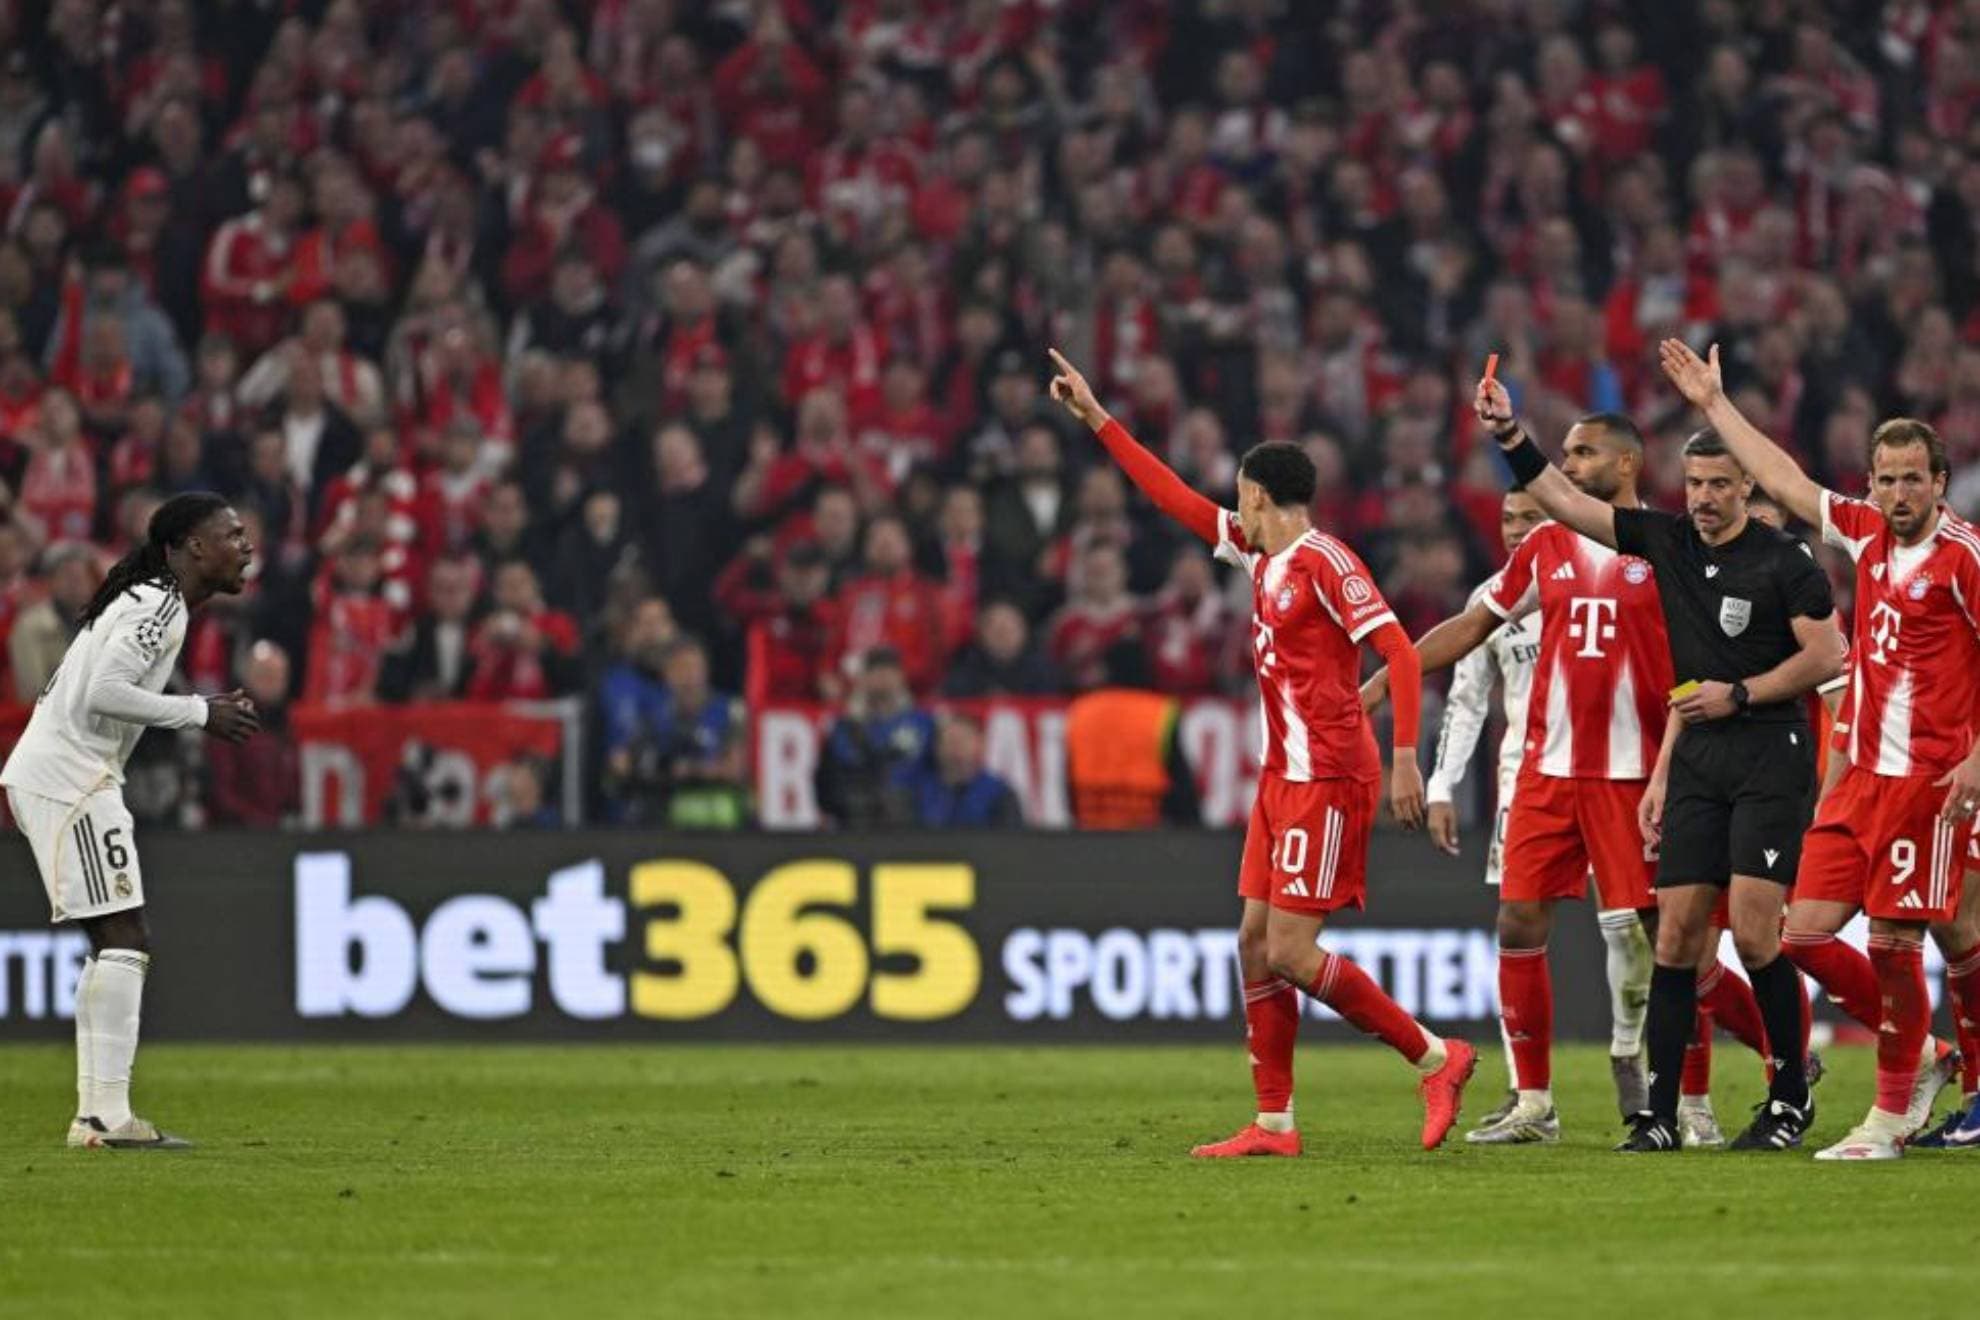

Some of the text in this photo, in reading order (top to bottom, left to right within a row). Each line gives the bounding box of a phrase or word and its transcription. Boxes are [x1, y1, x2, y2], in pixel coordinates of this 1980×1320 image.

[1569, 597, 1616, 657] T
[1869, 600, 1901, 665] T
[104, 828, 128, 869] 6
[1891, 838, 1916, 884] 9
[295, 851, 1498, 1019] bet365 SPORTTTEN
